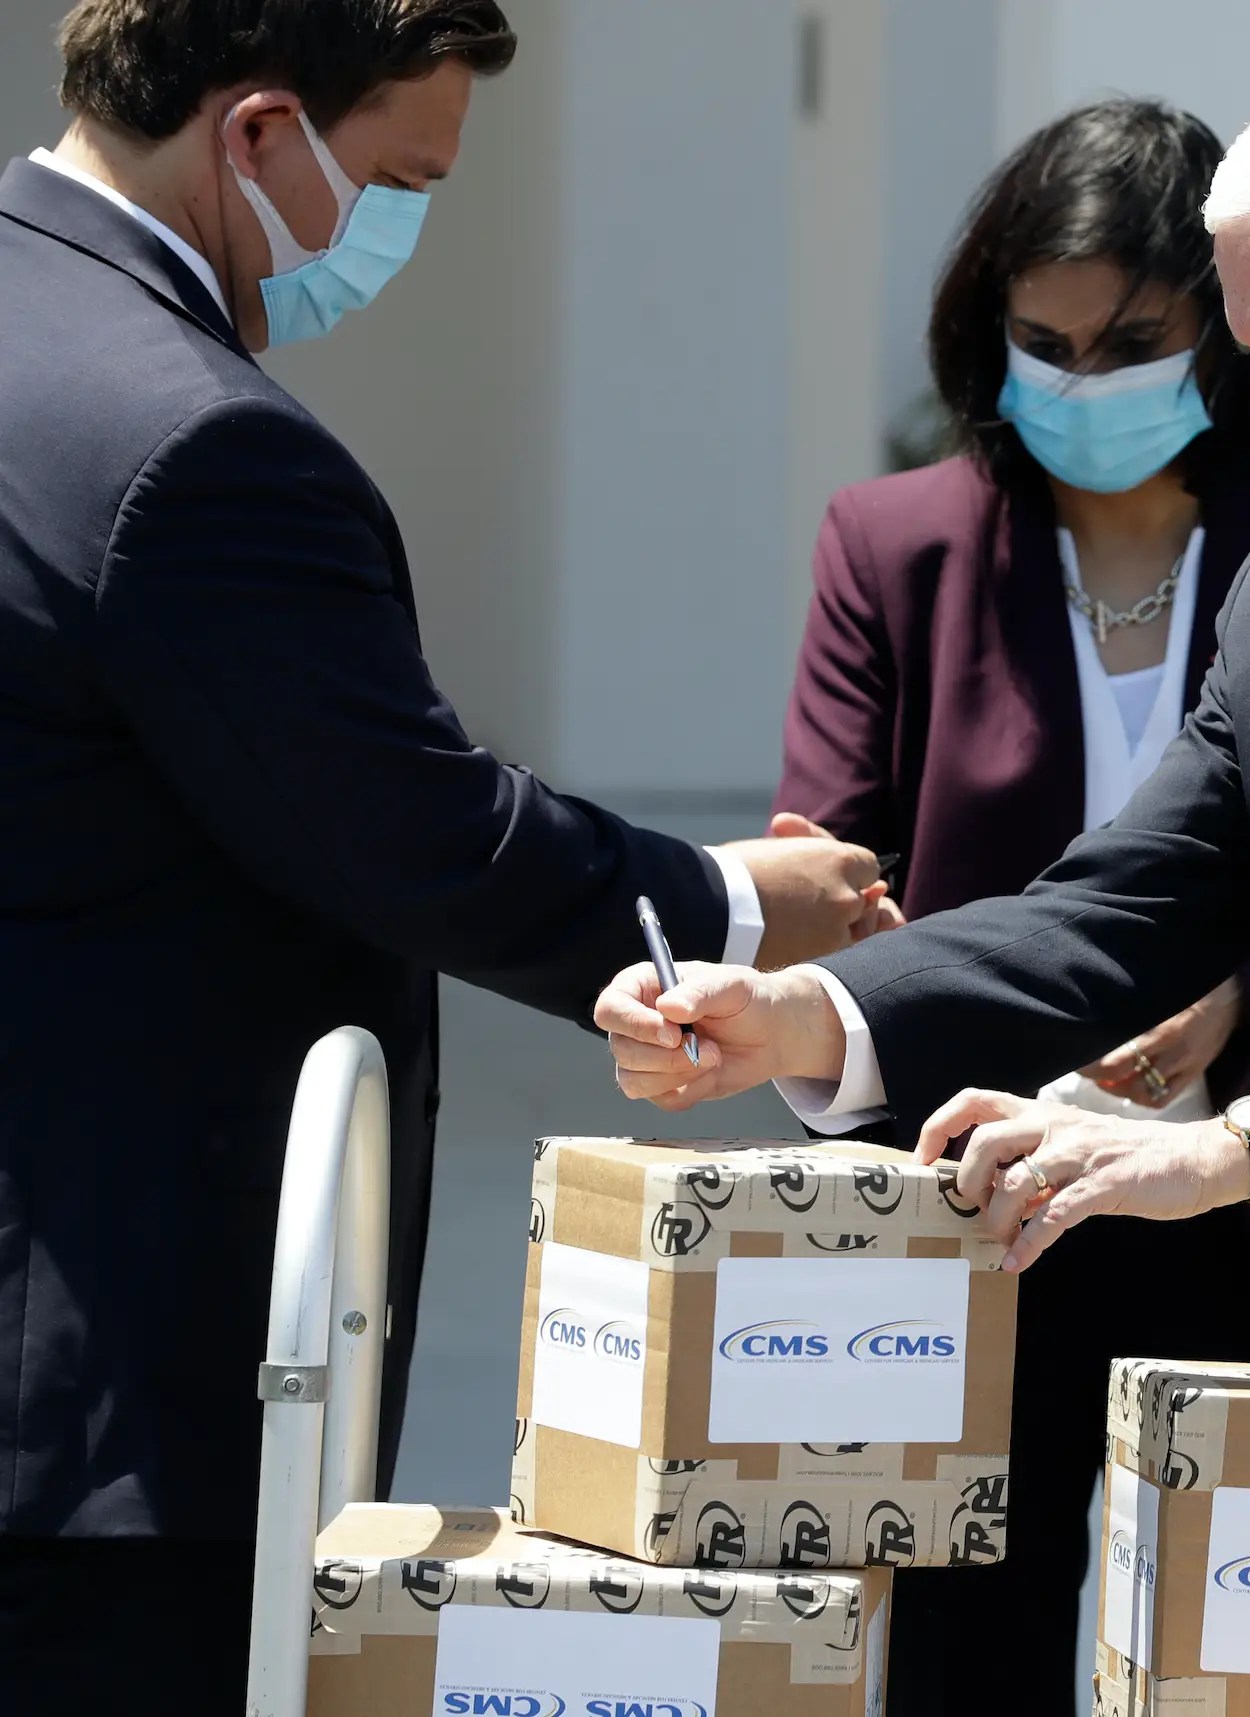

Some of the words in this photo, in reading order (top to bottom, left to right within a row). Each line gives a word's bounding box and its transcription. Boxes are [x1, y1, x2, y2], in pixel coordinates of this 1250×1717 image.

[549, 1320, 586, 1348] CMS
[602, 1333, 641, 1361] CMS
[741, 1335, 829, 1357] CMS
[869, 1335, 956, 1357] CMS
[1113, 1542, 1131, 1570] CMS
[1137, 1556, 1155, 1585] CMS
[444, 1692, 541, 1717] CMS
[585, 1701, 683, 1717] CMS
